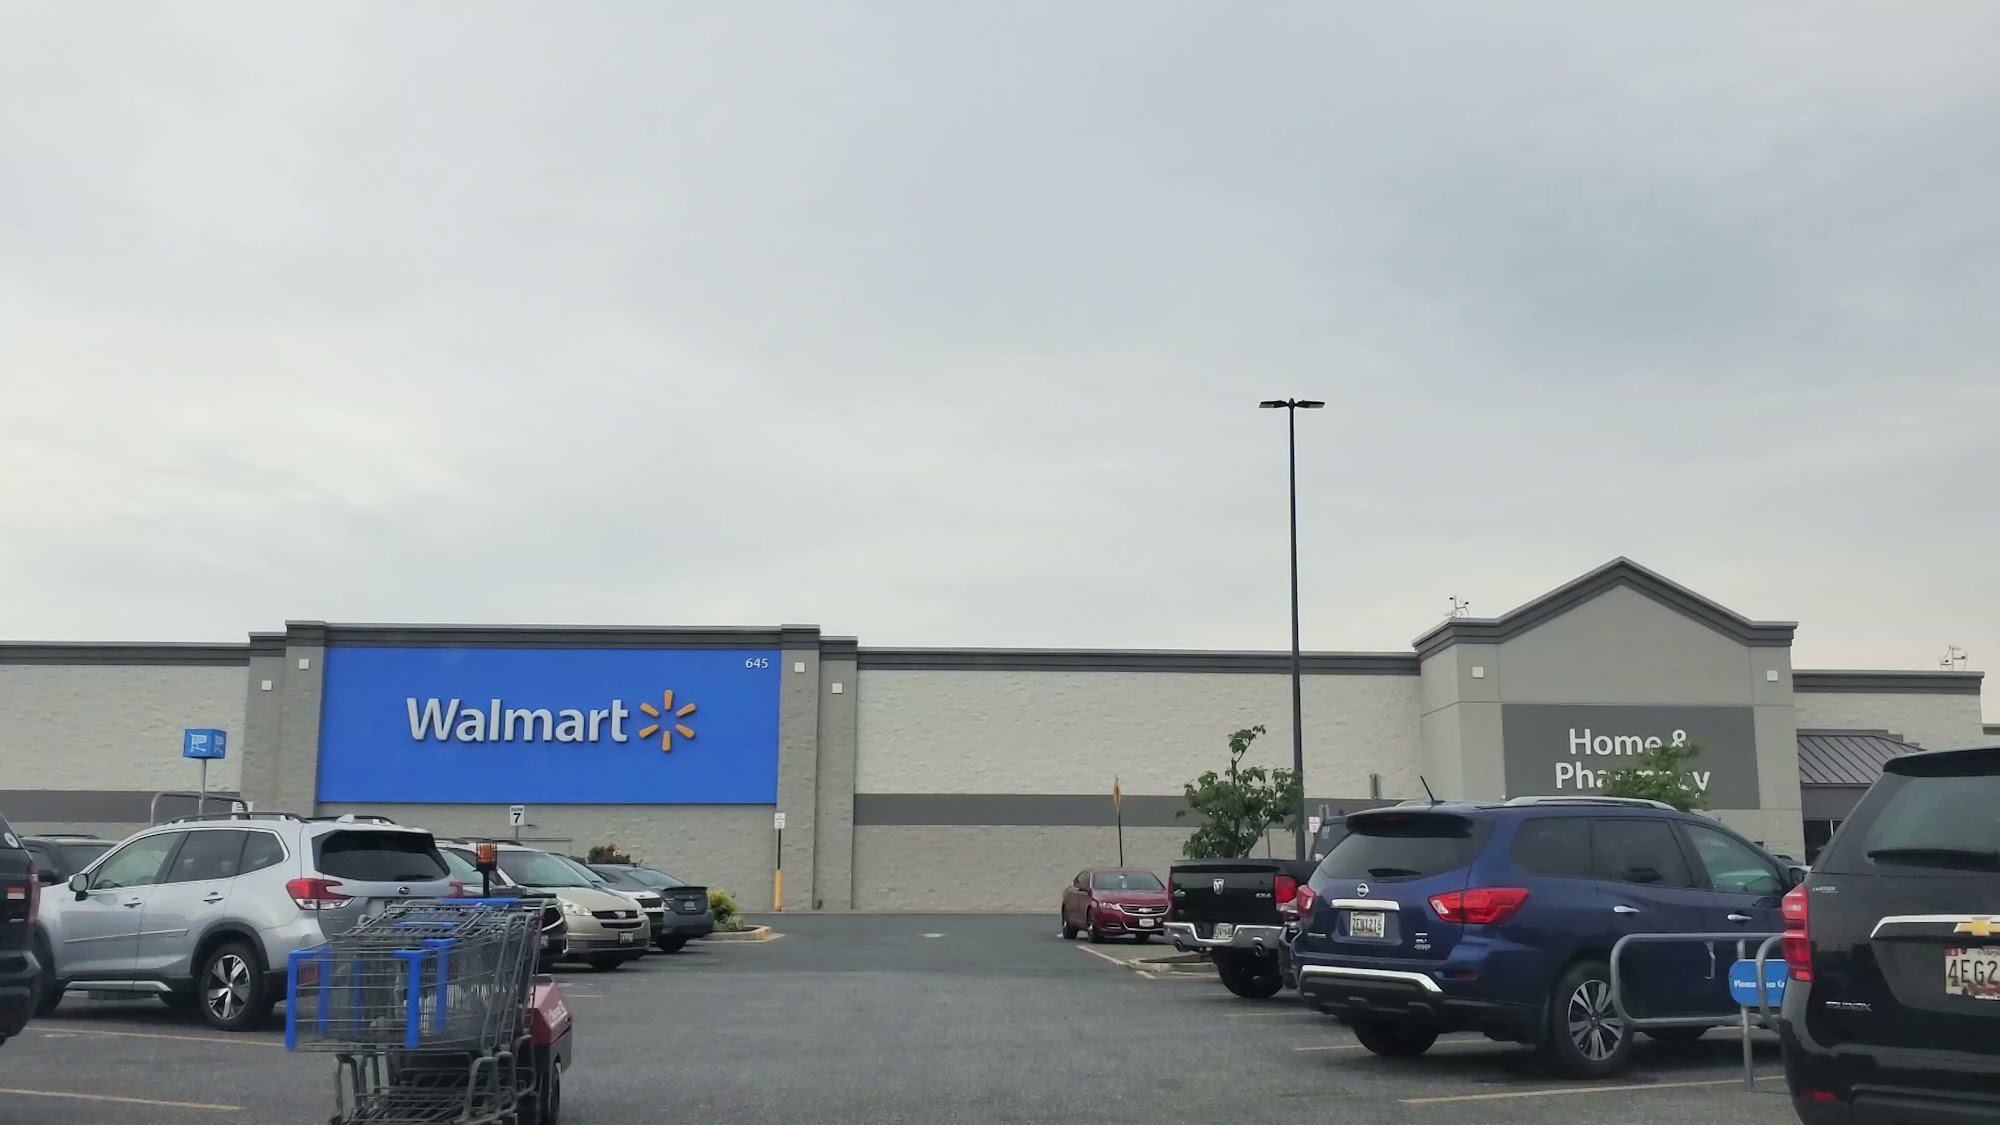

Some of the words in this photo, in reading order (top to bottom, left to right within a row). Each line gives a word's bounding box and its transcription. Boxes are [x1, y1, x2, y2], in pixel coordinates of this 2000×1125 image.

[745, 657, 769, 669] 645
[406, 697, 629, 743] Walmart
[1569, 728, 1663, 756] Home
[1670, 729, 1690, 754] &
[1555, 762, 1711, 799] Phay
[513, 812, 521, 824] 7
[1948, 959, 1998, 986] 4EG2
